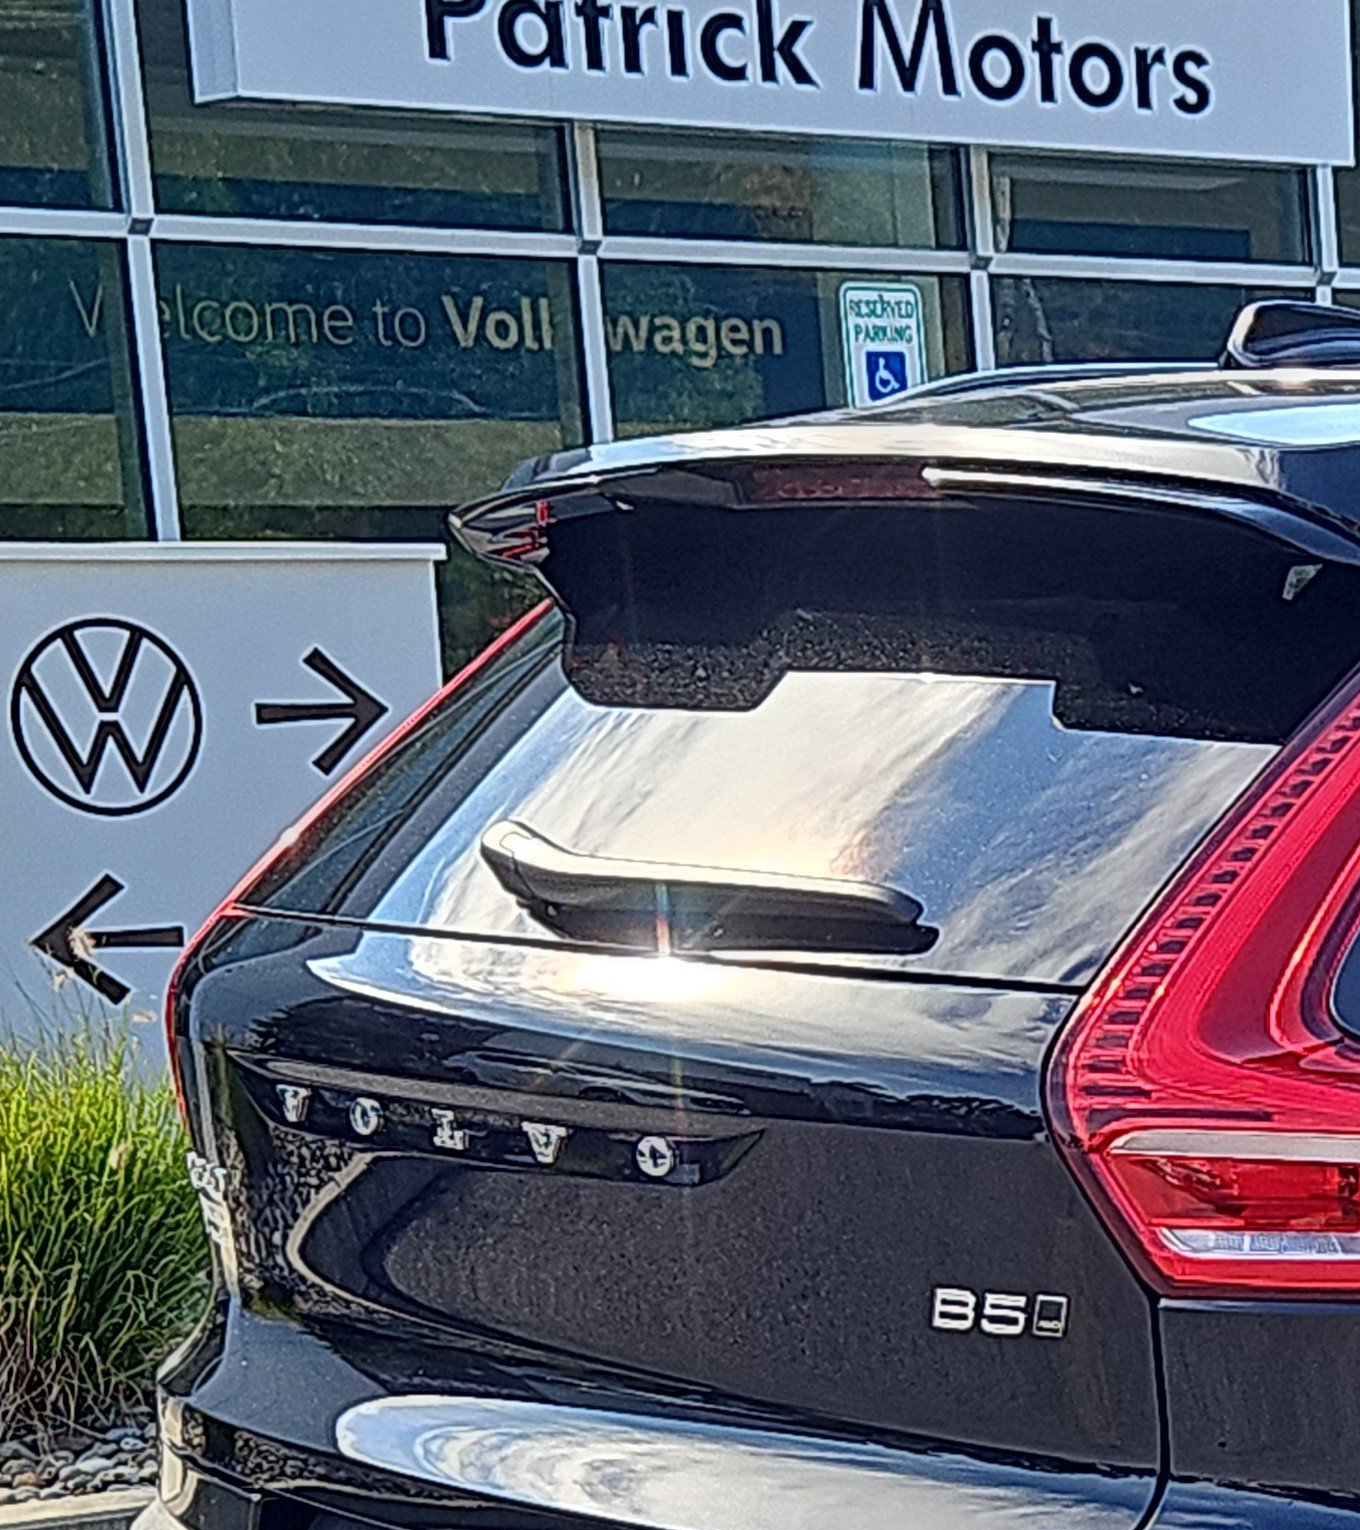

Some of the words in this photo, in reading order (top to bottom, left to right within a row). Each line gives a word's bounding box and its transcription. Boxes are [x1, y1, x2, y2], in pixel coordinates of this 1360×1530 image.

[425, 0, 818, 86] Patrick
[858, 0, 1211, 115] Motors
[372, 298, 426, 347] to
[440, 295, 783, 368] Volwagen
[849, 298, 915, 319] RESERVED
[853, 323, 914, 344] PARKING
[276, 1083, 679, 1177] VOLVO
[932, 1287, 1027, 1336] B5
